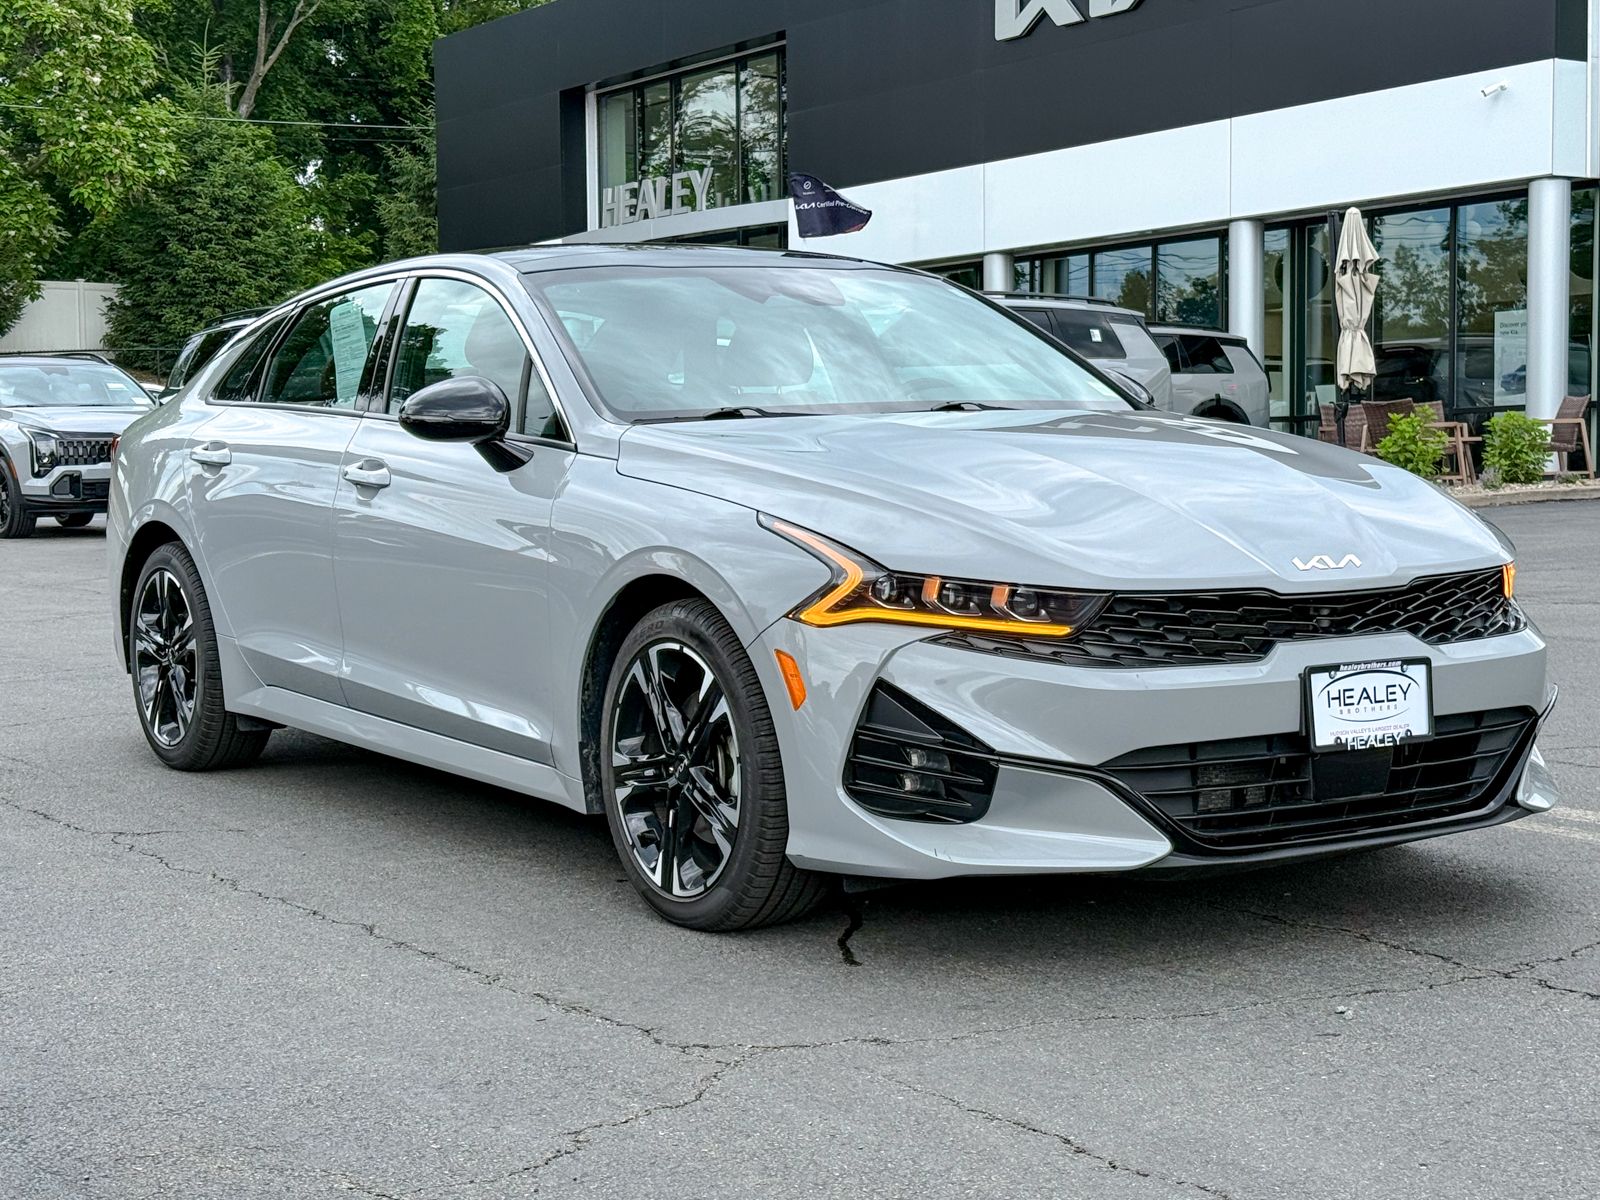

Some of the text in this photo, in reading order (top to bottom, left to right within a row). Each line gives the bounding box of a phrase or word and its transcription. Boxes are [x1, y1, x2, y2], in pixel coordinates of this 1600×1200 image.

[602, 167, 714, 228] HEALEY
[1291, 553, 1362, 571] KIA
[1339, 660, 1402, 671] healeybrothers.com
[1327, 683, 1411, 708] HEALEY
[1339, 704, 1398, 715] BROTHERS
[1350, 727, 1371, 735] VALLEY'S
[1371, 725, 1392, 733] LARGEST
[1347, 732, 1402, 750] HEALEY
